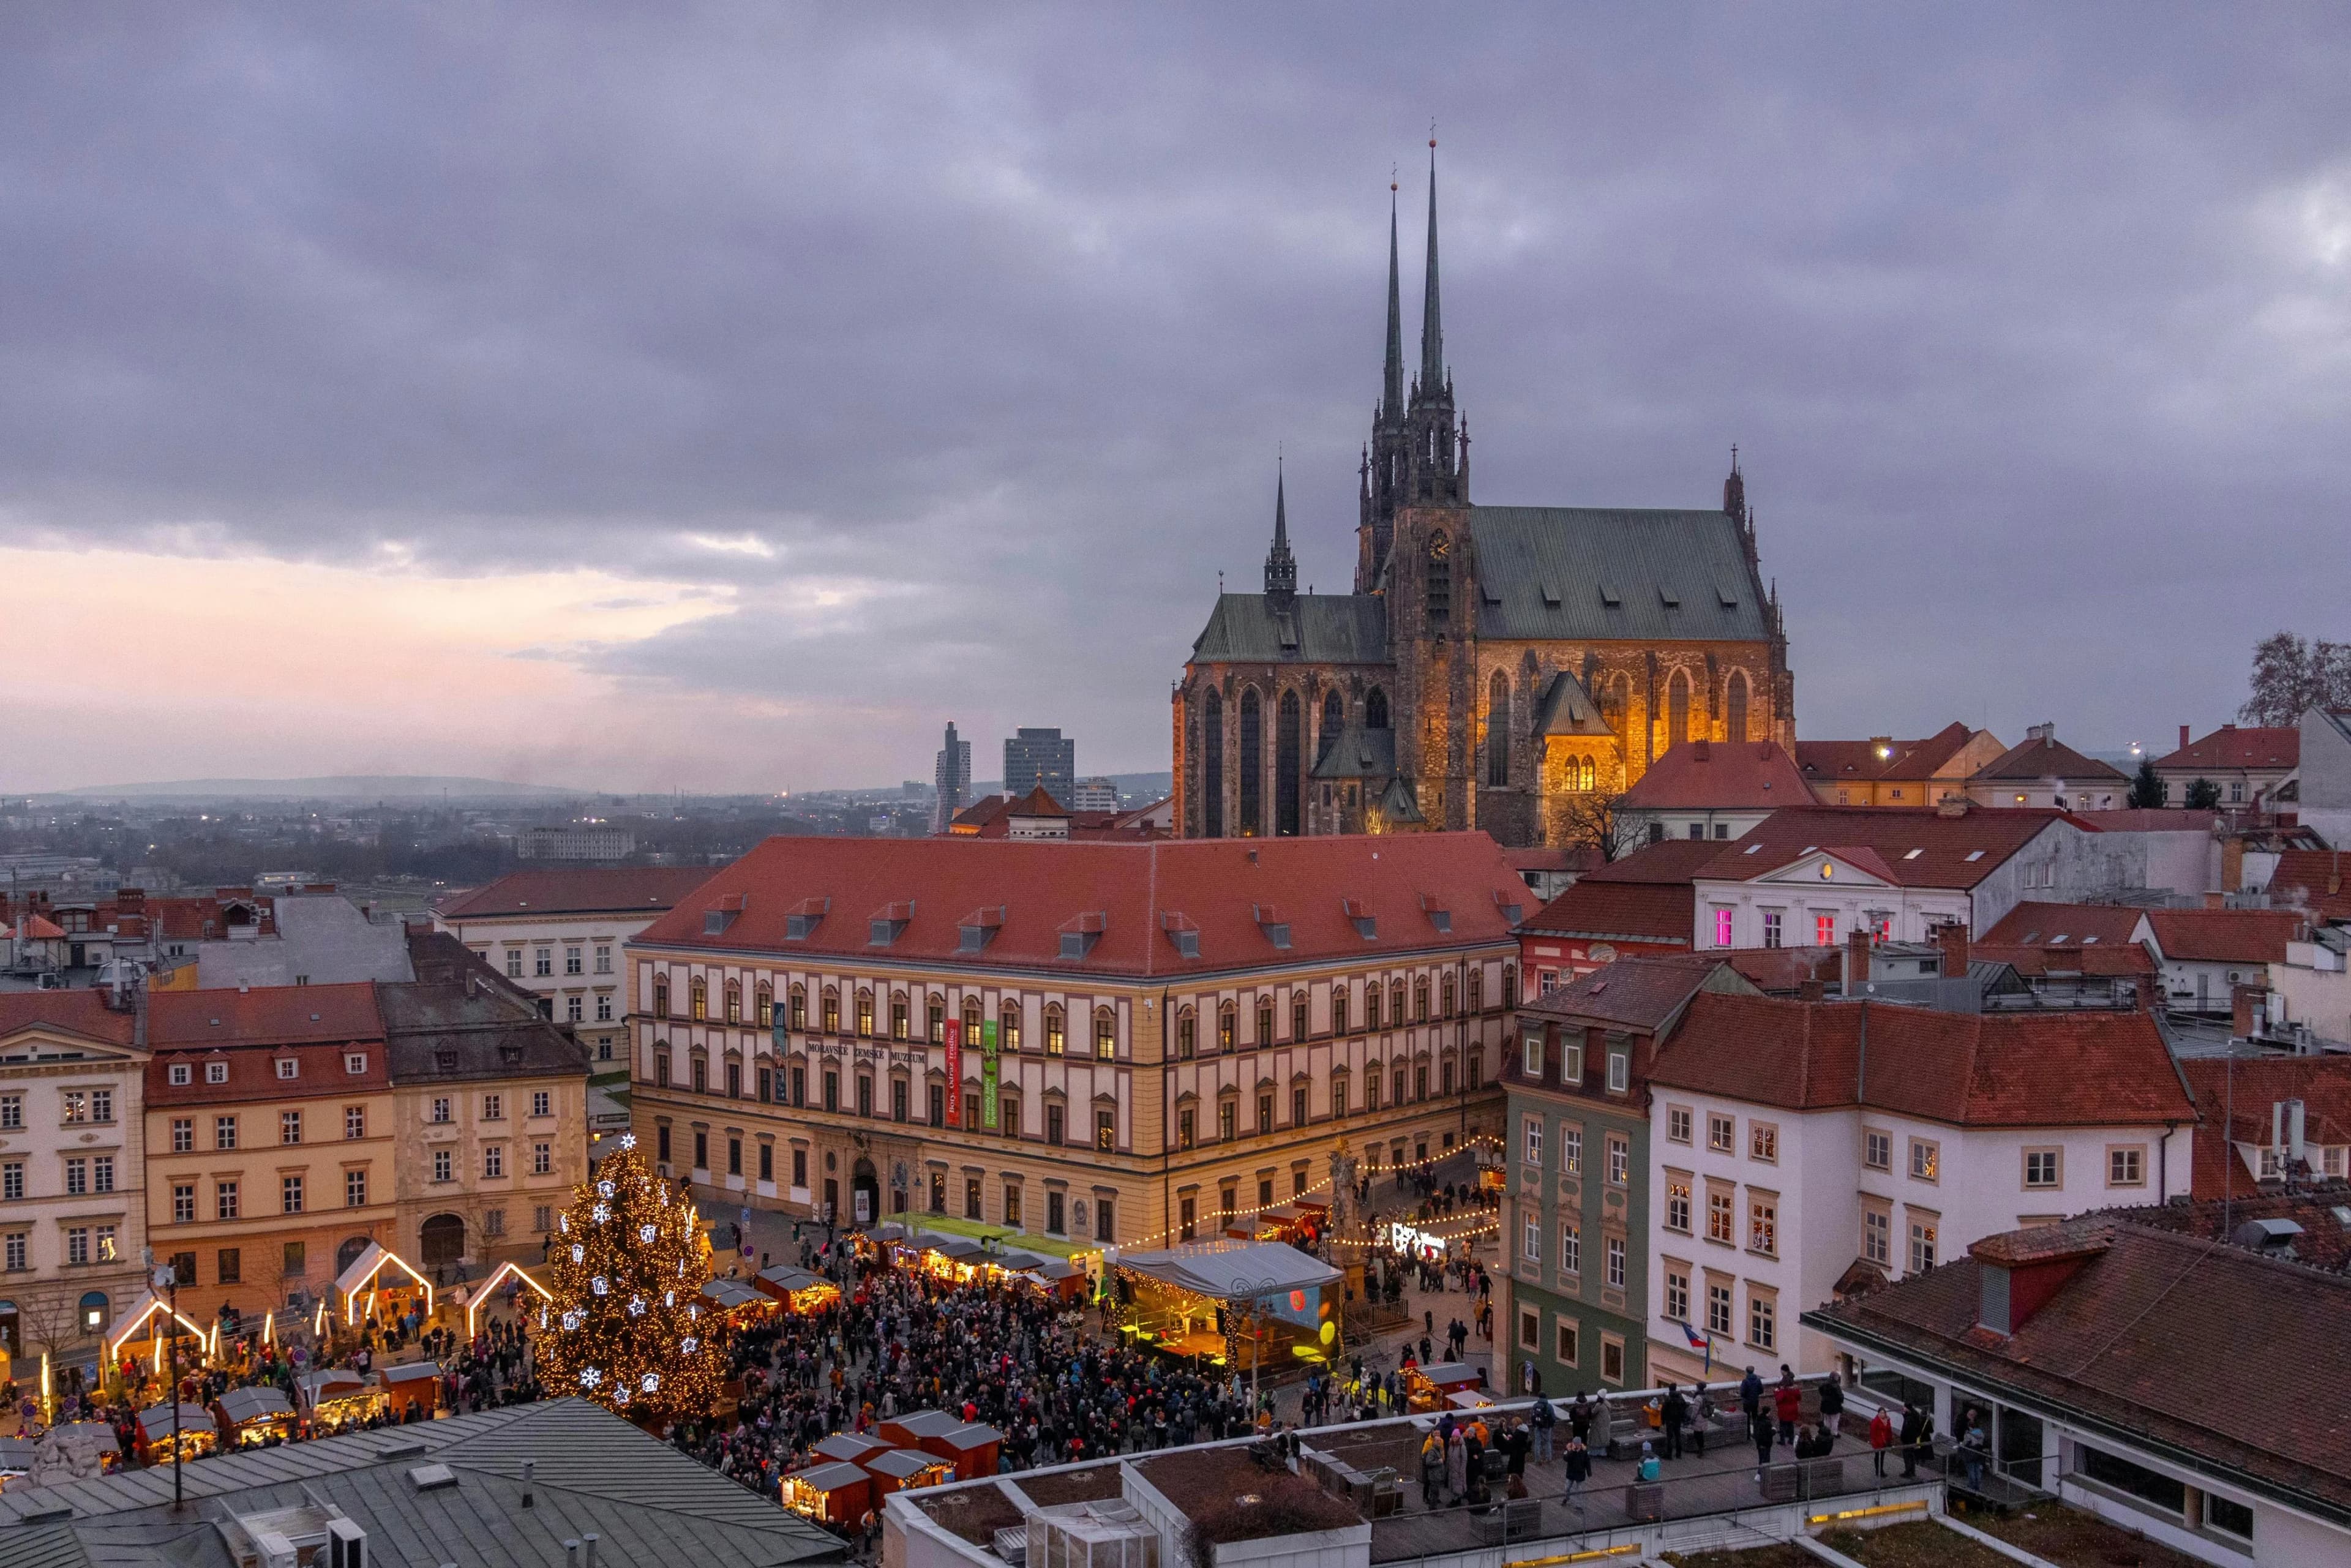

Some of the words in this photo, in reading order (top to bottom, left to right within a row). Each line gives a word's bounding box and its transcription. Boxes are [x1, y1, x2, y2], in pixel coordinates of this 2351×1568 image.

[808, 1043, 849, 1056] MORAVSKÉ
[853, 1048, 884, 1059] ZEMSKÉ
[891, 1052, 925, 1063] MUZEUM
